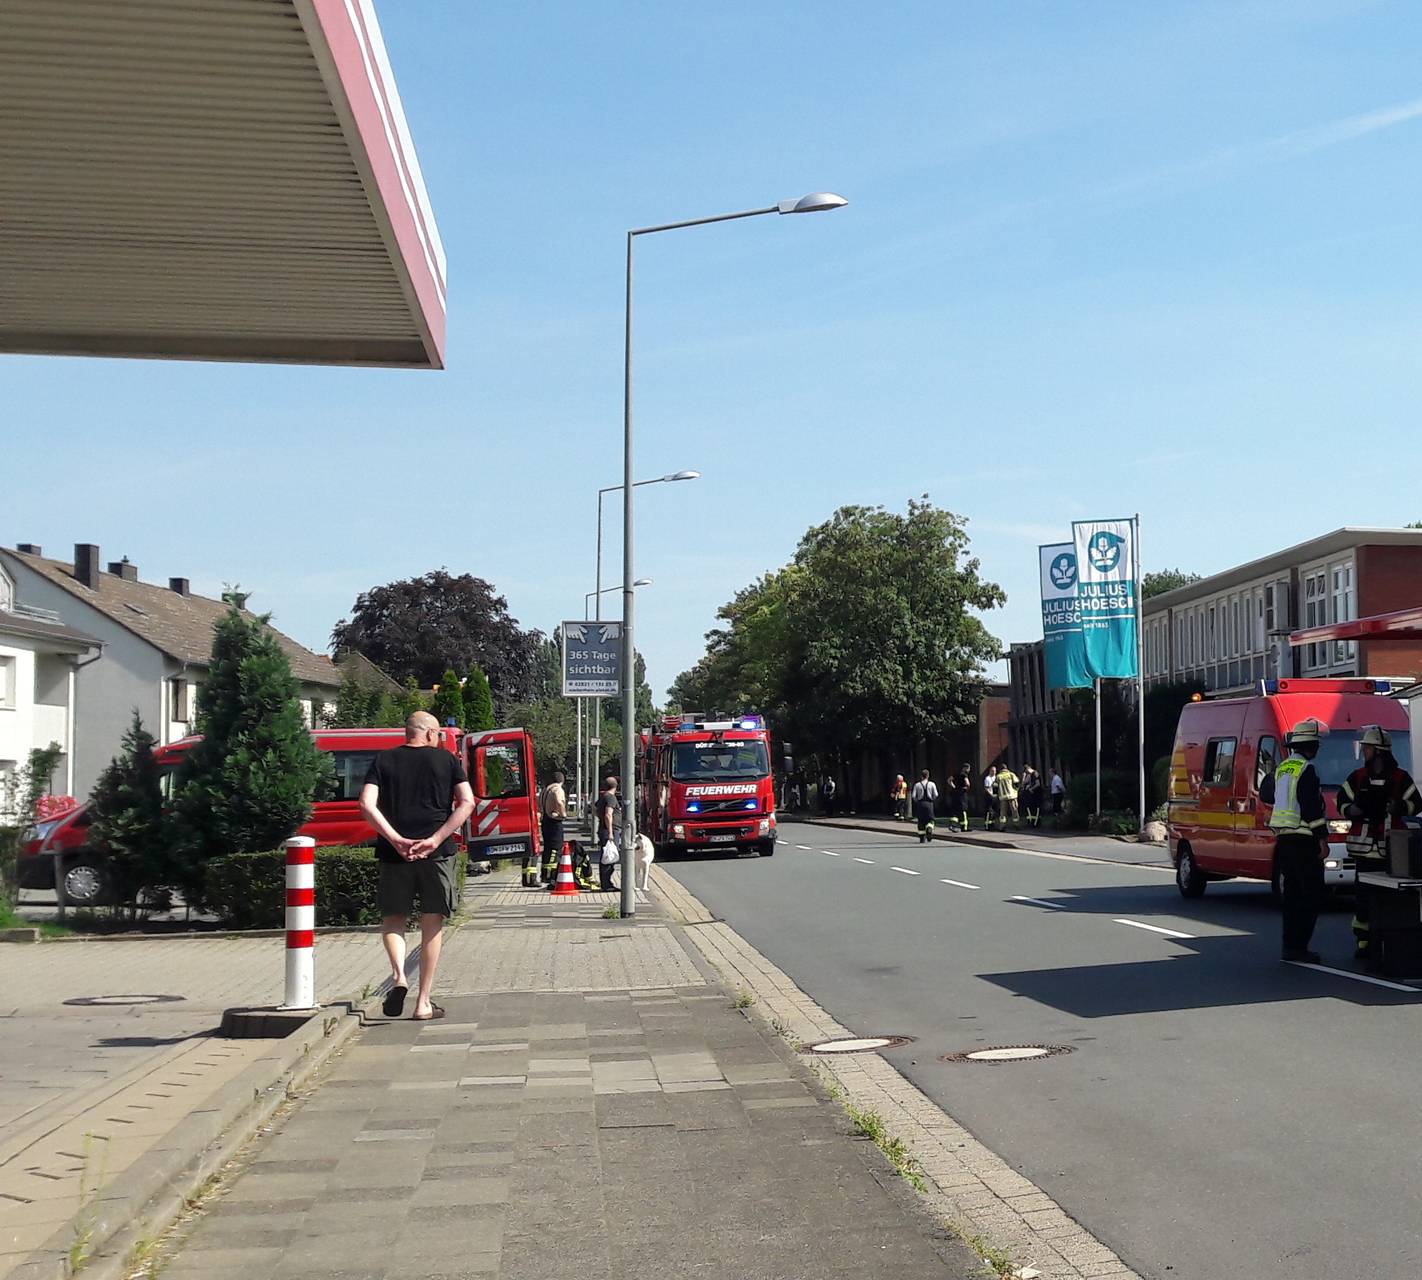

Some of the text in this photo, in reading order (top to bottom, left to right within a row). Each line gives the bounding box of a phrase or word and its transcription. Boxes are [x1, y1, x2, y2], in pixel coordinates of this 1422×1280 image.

[1081, 584, 1127, 597] JULIUS
[1043, 612, 1081, 626] HOESC
[569, 650, 617, 662] 365 Tage
[569, 664, 616, 674] sichtbar
[685, 784, 758, 797] FEUERWEHR
